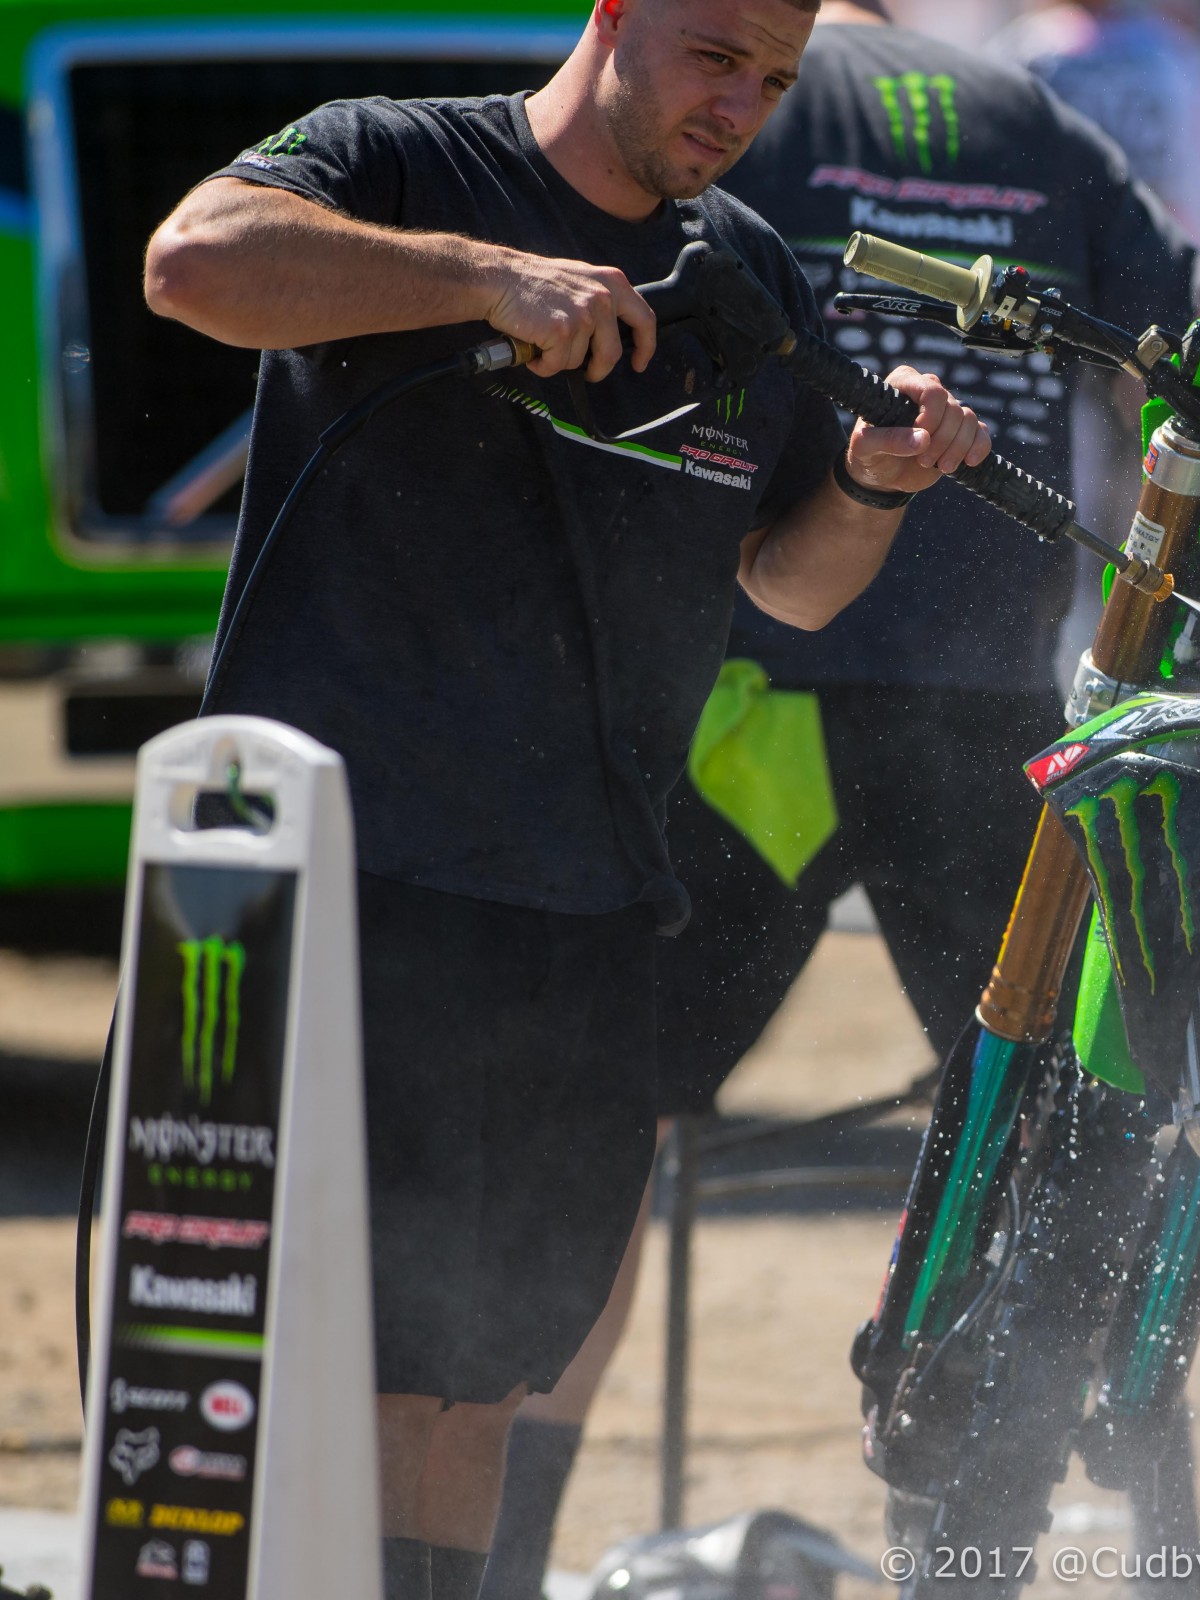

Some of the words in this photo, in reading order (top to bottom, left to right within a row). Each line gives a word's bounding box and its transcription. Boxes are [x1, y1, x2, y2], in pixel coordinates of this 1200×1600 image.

[849, 196, 1014, 247] Kawasaki
[873, 300, 921, 313] ARC
[691, 424, 749, 451] MONSTER
[680, 444, 711, 460] PRO
[709, 453, 758, 473] CIRCUIT
[685, 460, 751, 490] Kawasaki
[128, 1263, 258, 1316] Kawasaki
